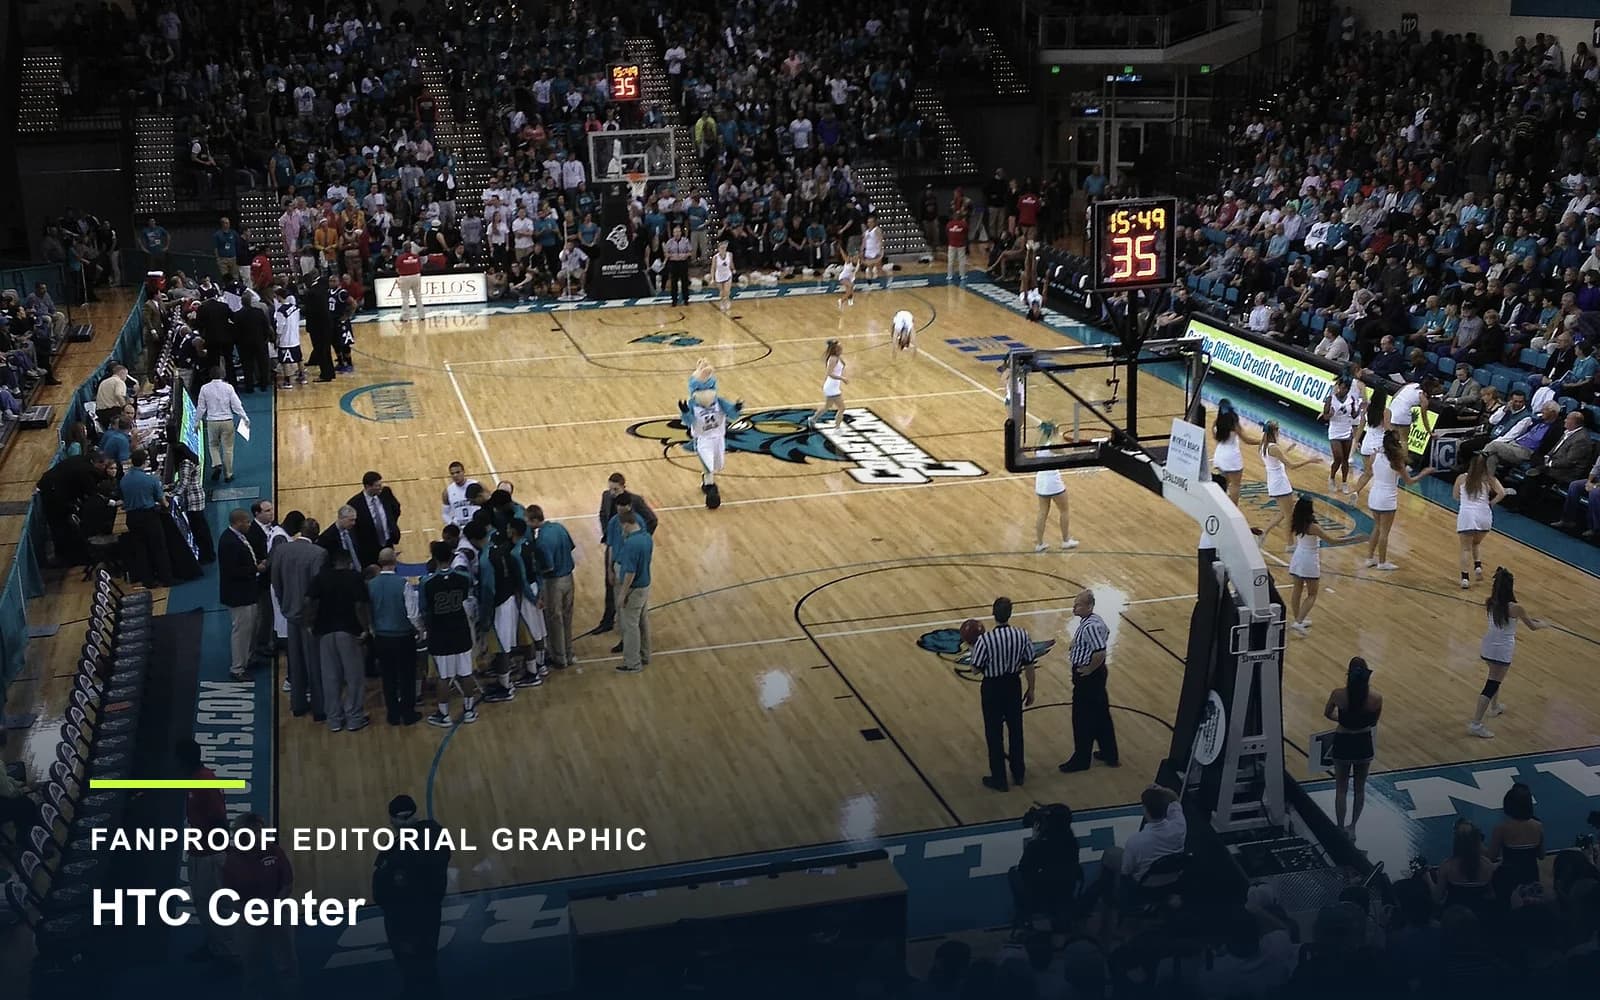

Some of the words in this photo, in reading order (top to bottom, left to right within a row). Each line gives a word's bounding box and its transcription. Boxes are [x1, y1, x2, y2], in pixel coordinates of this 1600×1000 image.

[1402, 18, 1417, 33] 112
[614, 78, 635, 96] 35
[1110, 207, 1165, 234] 15:49
[1112, 235, 1157, 278] 35
[387, 279, 476, 297] AUELO'S
[283, 349, 294, 362] A
[1213, 340, 1243, 368] Official
[1242, 353, 1272, 379] Credit
[1269, 363, 1296, 388] Card
[1291, 373, 1306, 392] of
[1302, 376, 1328, 401] CCU
[842, 406, 989, 477] CAROLINA
[1440, 444, 1455, 467] C
[1162, 468, 1189, 491] SPALDING
[434, 591, 464, 614] 20
